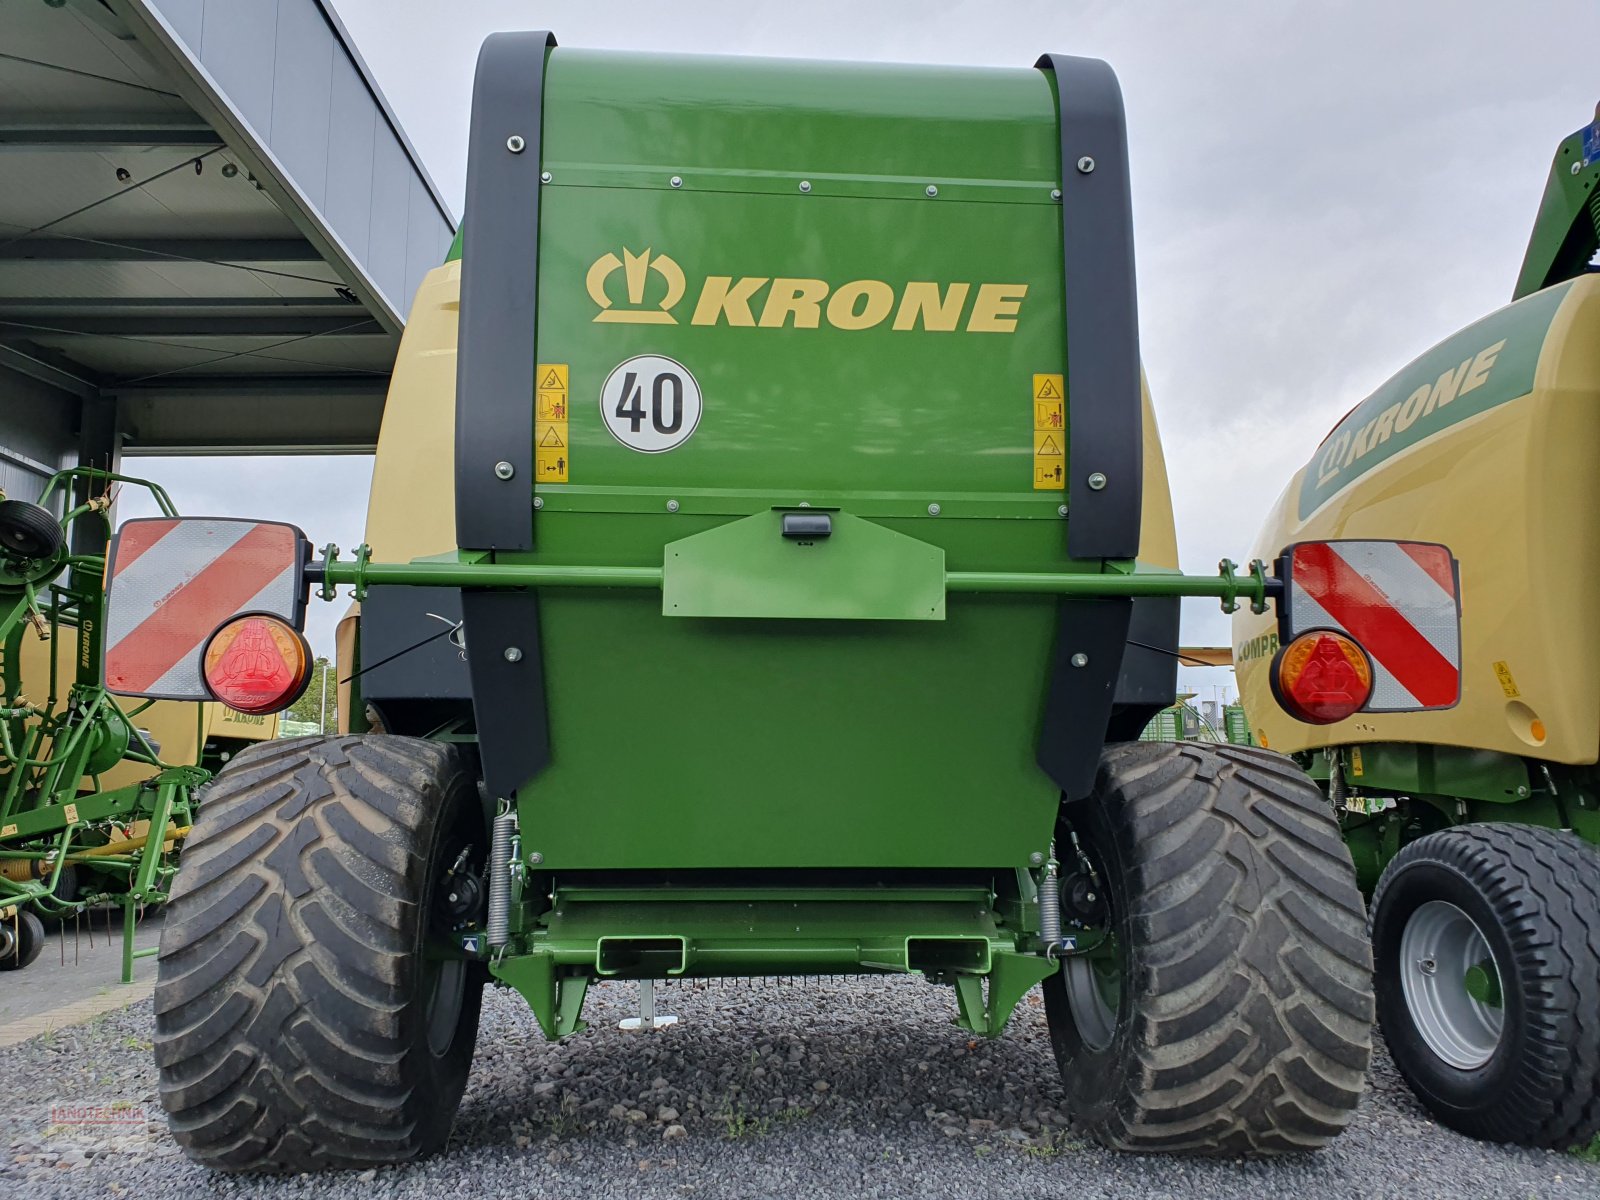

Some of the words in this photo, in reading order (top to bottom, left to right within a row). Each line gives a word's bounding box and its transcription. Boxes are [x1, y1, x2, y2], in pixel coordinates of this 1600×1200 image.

[691, 276, 1029, 333] KRONE
[615, 372, 683, 434] 40
[1343, 338, 1507, 468] KRONE
[82, 630, 90, 669] KRONE
